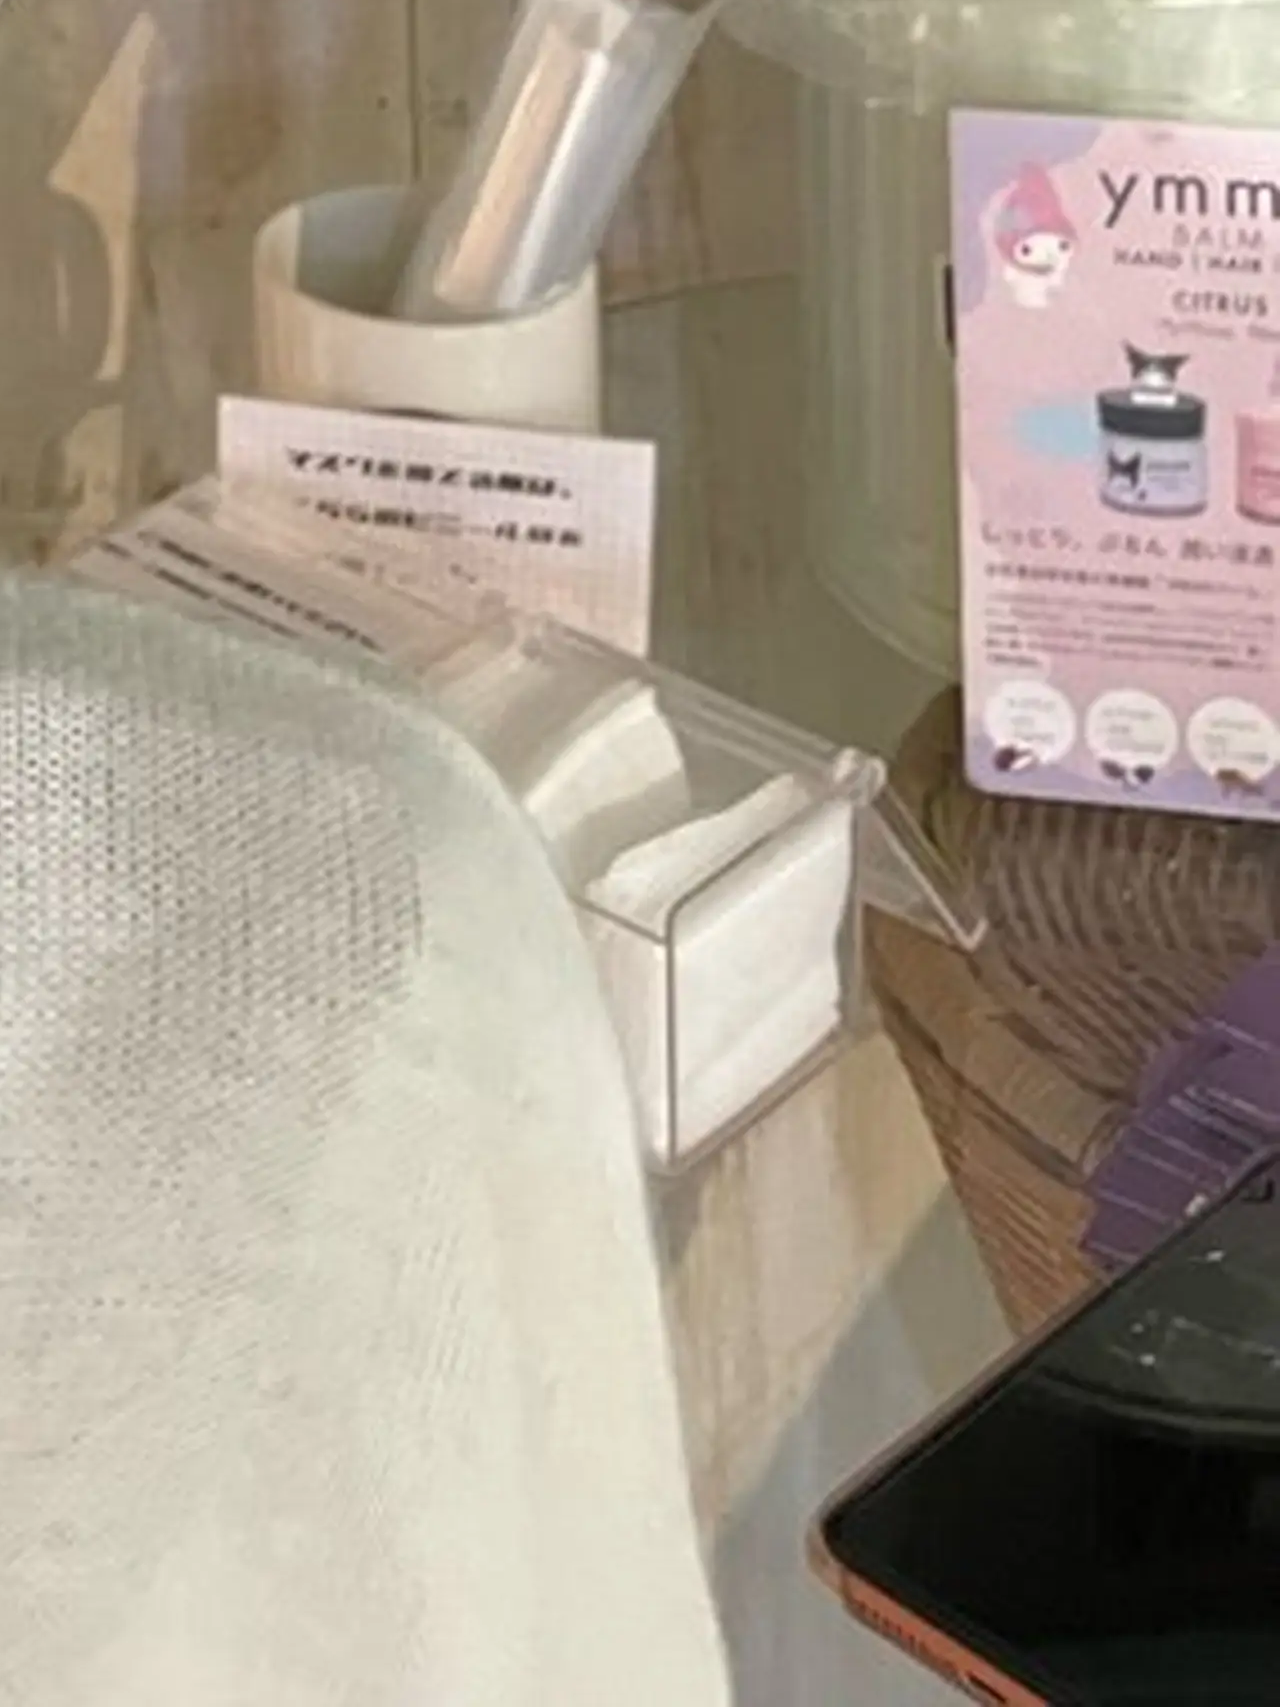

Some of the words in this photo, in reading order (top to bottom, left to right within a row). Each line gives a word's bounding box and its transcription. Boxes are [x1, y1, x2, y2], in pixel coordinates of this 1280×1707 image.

[1173, 223, 1263, 249] BALM
[1113, 247, 1183, 270] HAND
[1207, 255, 1263, 274] HAIR
[1172, 290, 1268, 317] CITRUS
